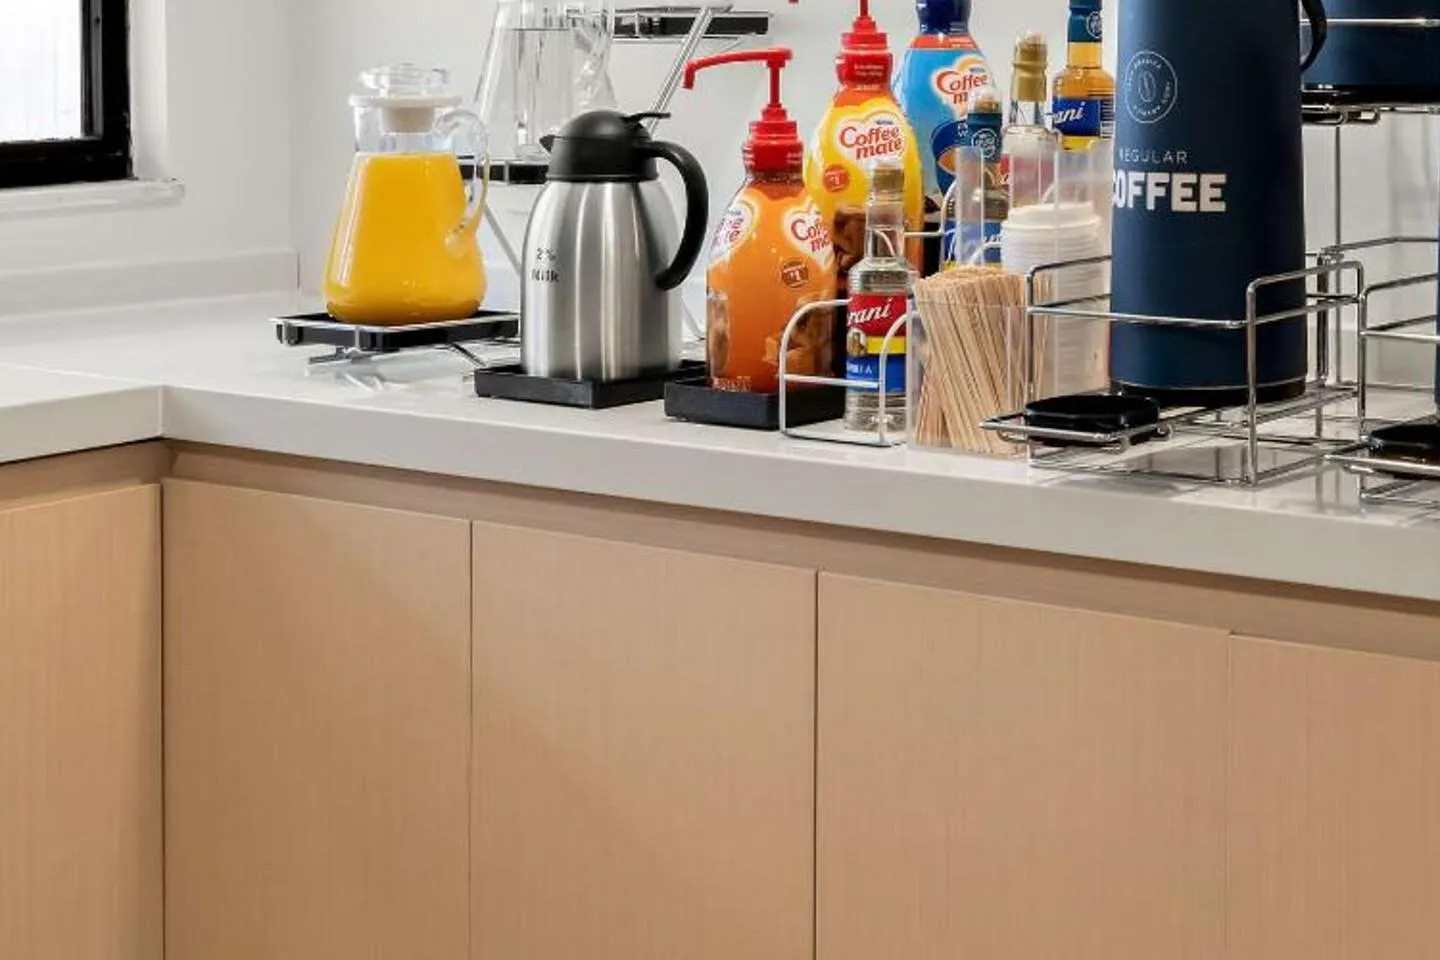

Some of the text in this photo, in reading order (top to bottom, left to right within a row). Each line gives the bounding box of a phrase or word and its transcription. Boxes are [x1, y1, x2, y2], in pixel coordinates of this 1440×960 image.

[936, 70, 988, 94] Coffee
[839, 126, 899, 148] Coffee
[856, 137, 902, 160] mate
[1119, 148, 1188, 164] REGULAR
[1113, 169, 1227, 213] OFFEE
[536, 247, 557, 261] 2%
[531, 269, 560, 283] Milk
[846, 298, 894, 327] rani
